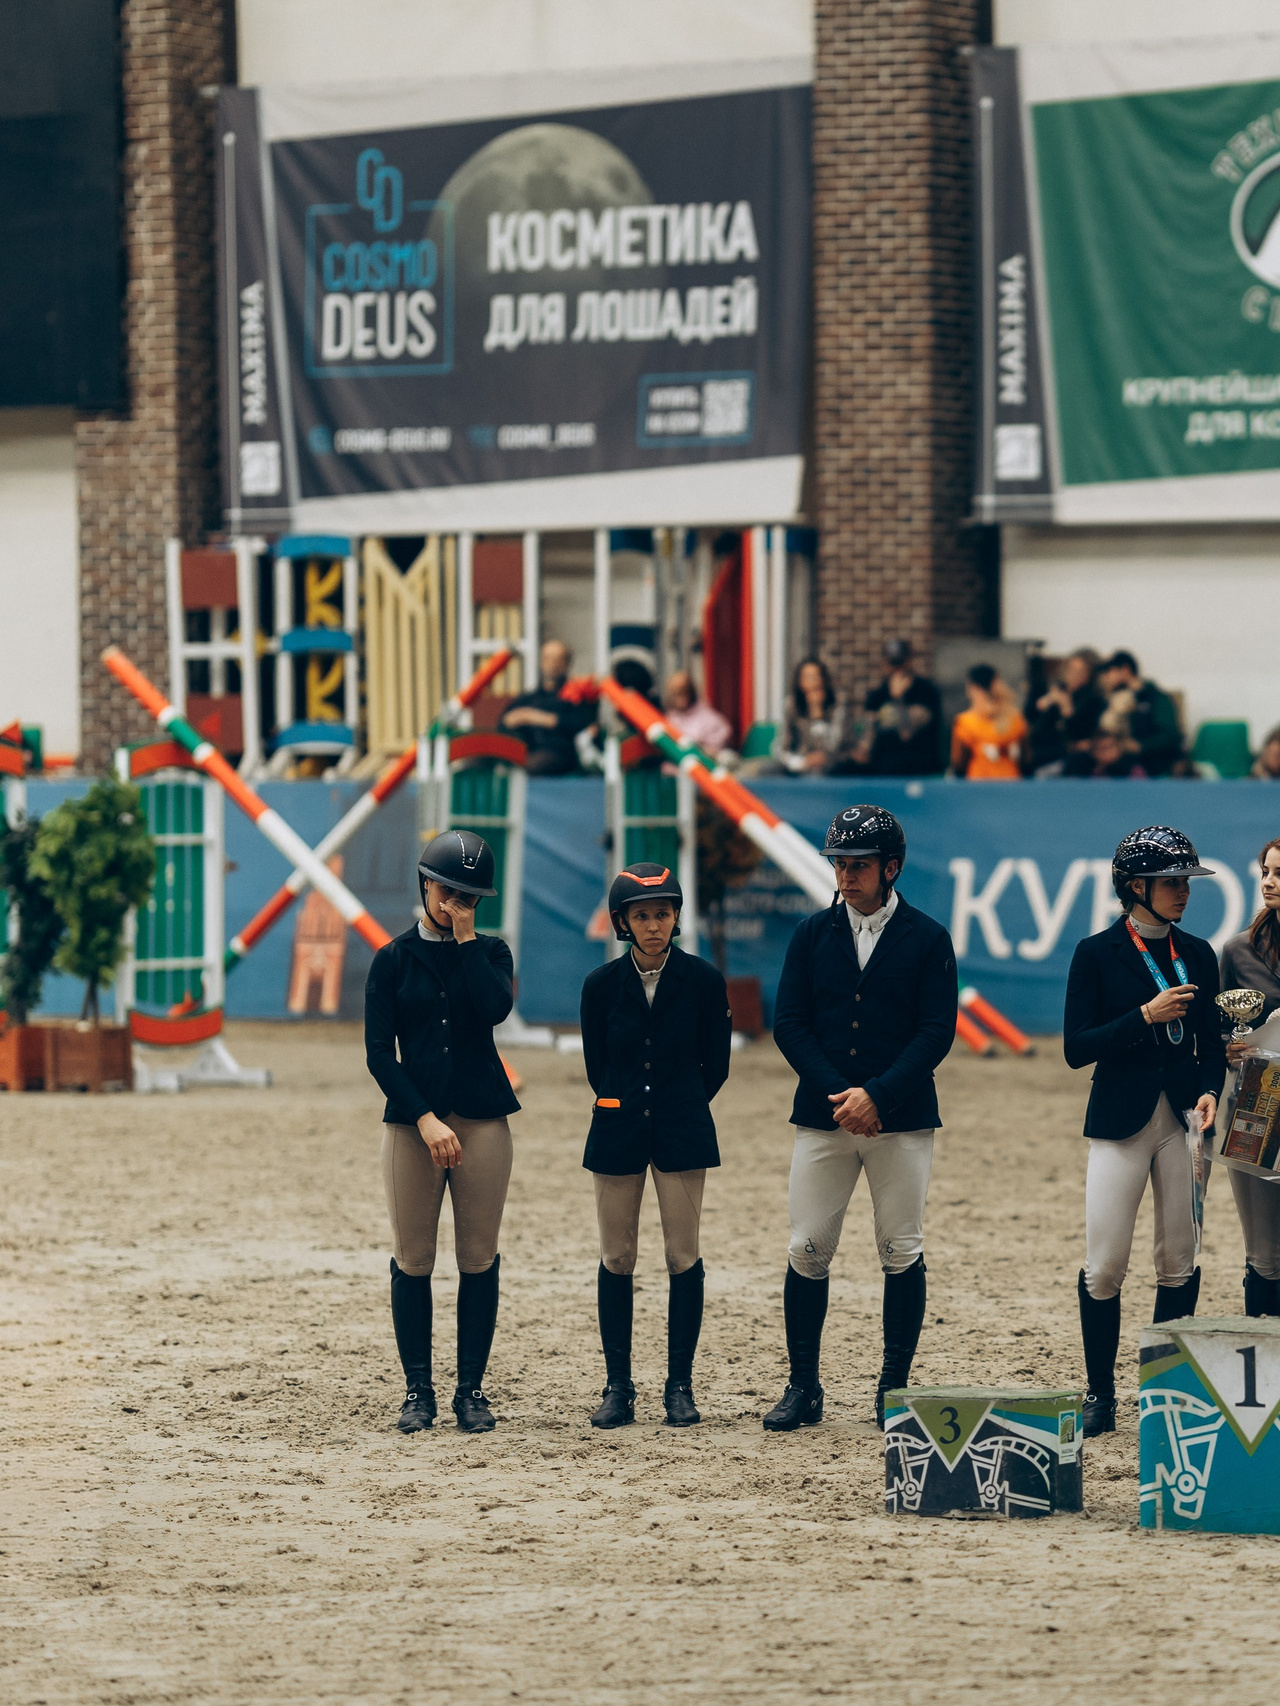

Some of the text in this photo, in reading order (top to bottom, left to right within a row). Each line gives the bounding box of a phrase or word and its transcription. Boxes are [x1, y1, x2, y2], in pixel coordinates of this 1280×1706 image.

[322, 239, 437, 291] COSMO
[487, 199, 759, 273] КОСМЕТИКА
[321, 290, 437, 361] DEUS
[483, 275, 758, 352] ДЛЯ ЛОШАДЕЙ
[998, 254, 1026, 405] MAXIMA
[240, 279, 267, 425] MAXIMA
[1185, 410, 1247, 445] ДЛЯ
[1270, 1071, 1280, 1088] 3000
[1235, 1346, 1266, 1408] 1
[938, 1406, 961, 1444] 3
